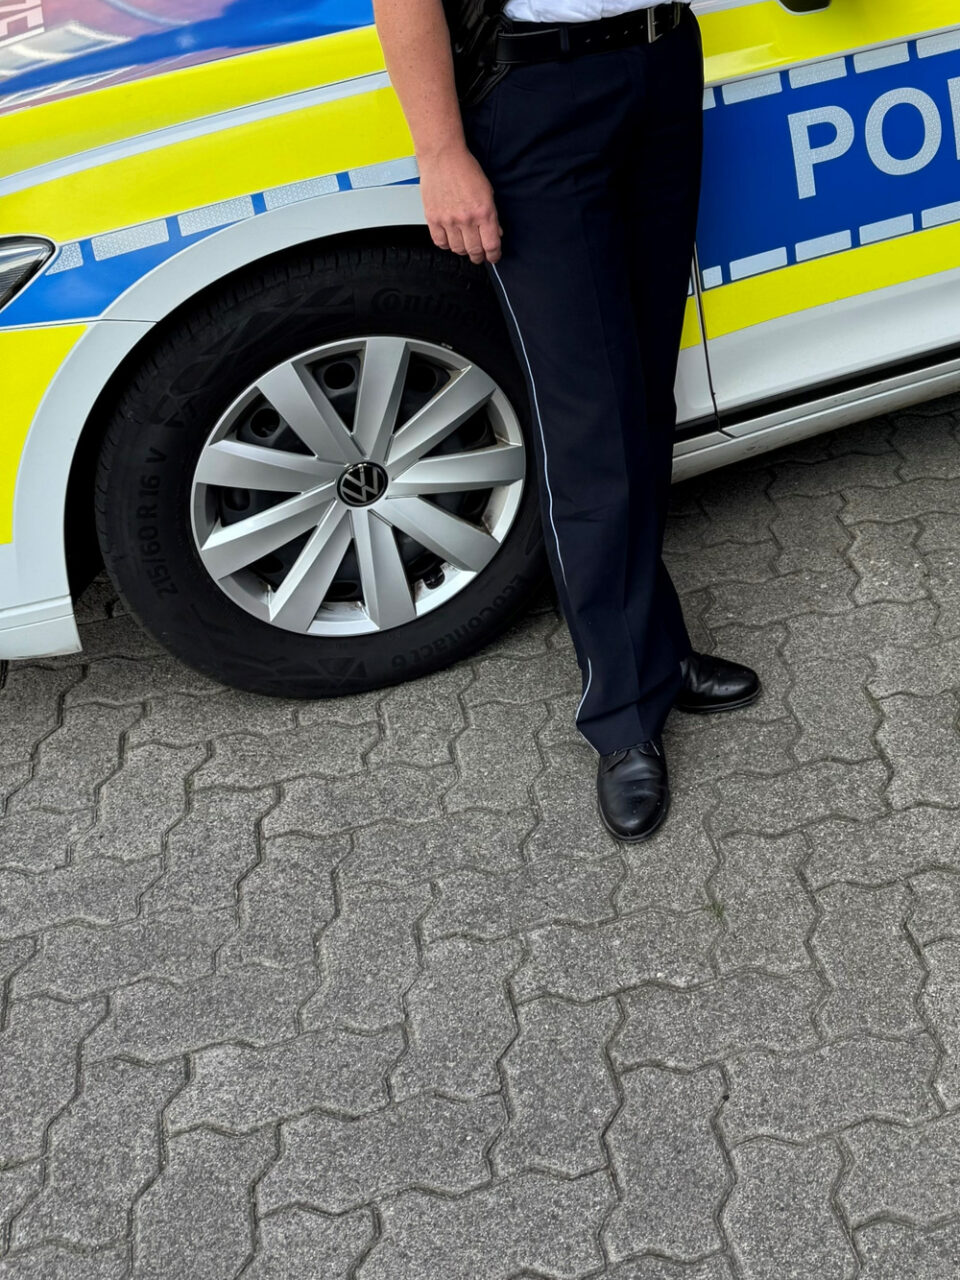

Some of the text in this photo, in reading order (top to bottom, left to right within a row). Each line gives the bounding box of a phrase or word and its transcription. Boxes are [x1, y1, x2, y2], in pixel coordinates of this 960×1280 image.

[136, 447, 178, 600] 215/60 R 16 V
